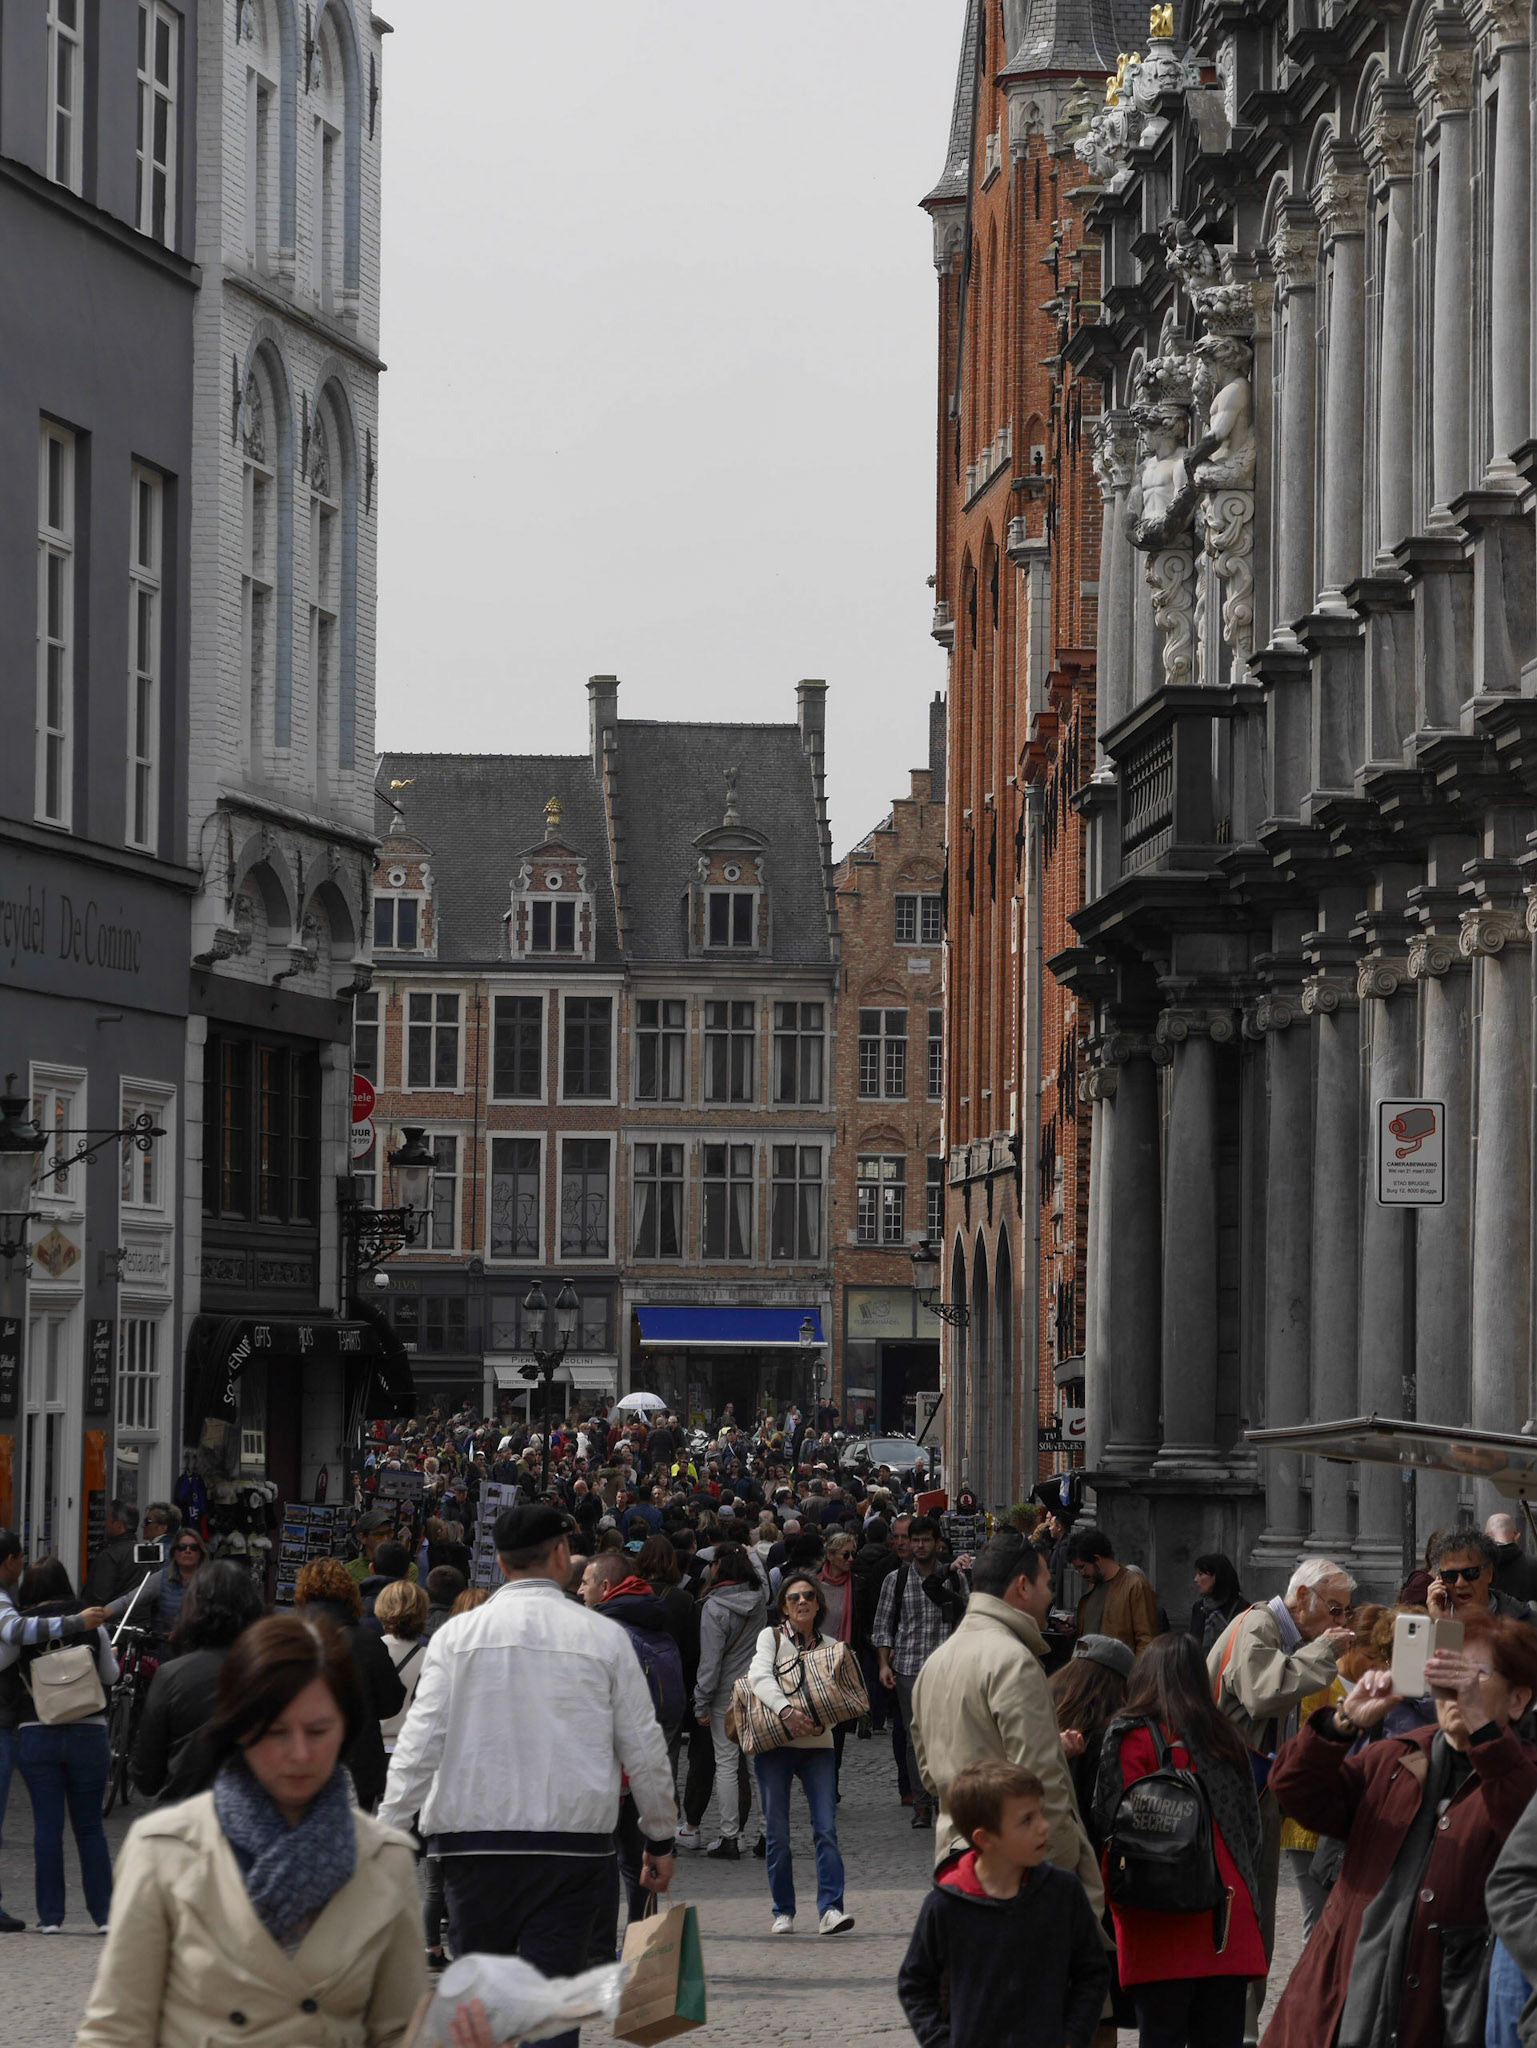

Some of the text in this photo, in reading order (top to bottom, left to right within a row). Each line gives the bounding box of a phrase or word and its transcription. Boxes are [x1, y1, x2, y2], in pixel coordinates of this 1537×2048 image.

[120, 1249, 161, 1273] estaurant
[366, 1280, 417, 1290] GDIVA
[337, 1330, 361, 1351] T-SHIRTS
[1129, 1794, 1194, 1817] VICTORIA'S
[1132, 1812, 1182, 1833] SECRET
